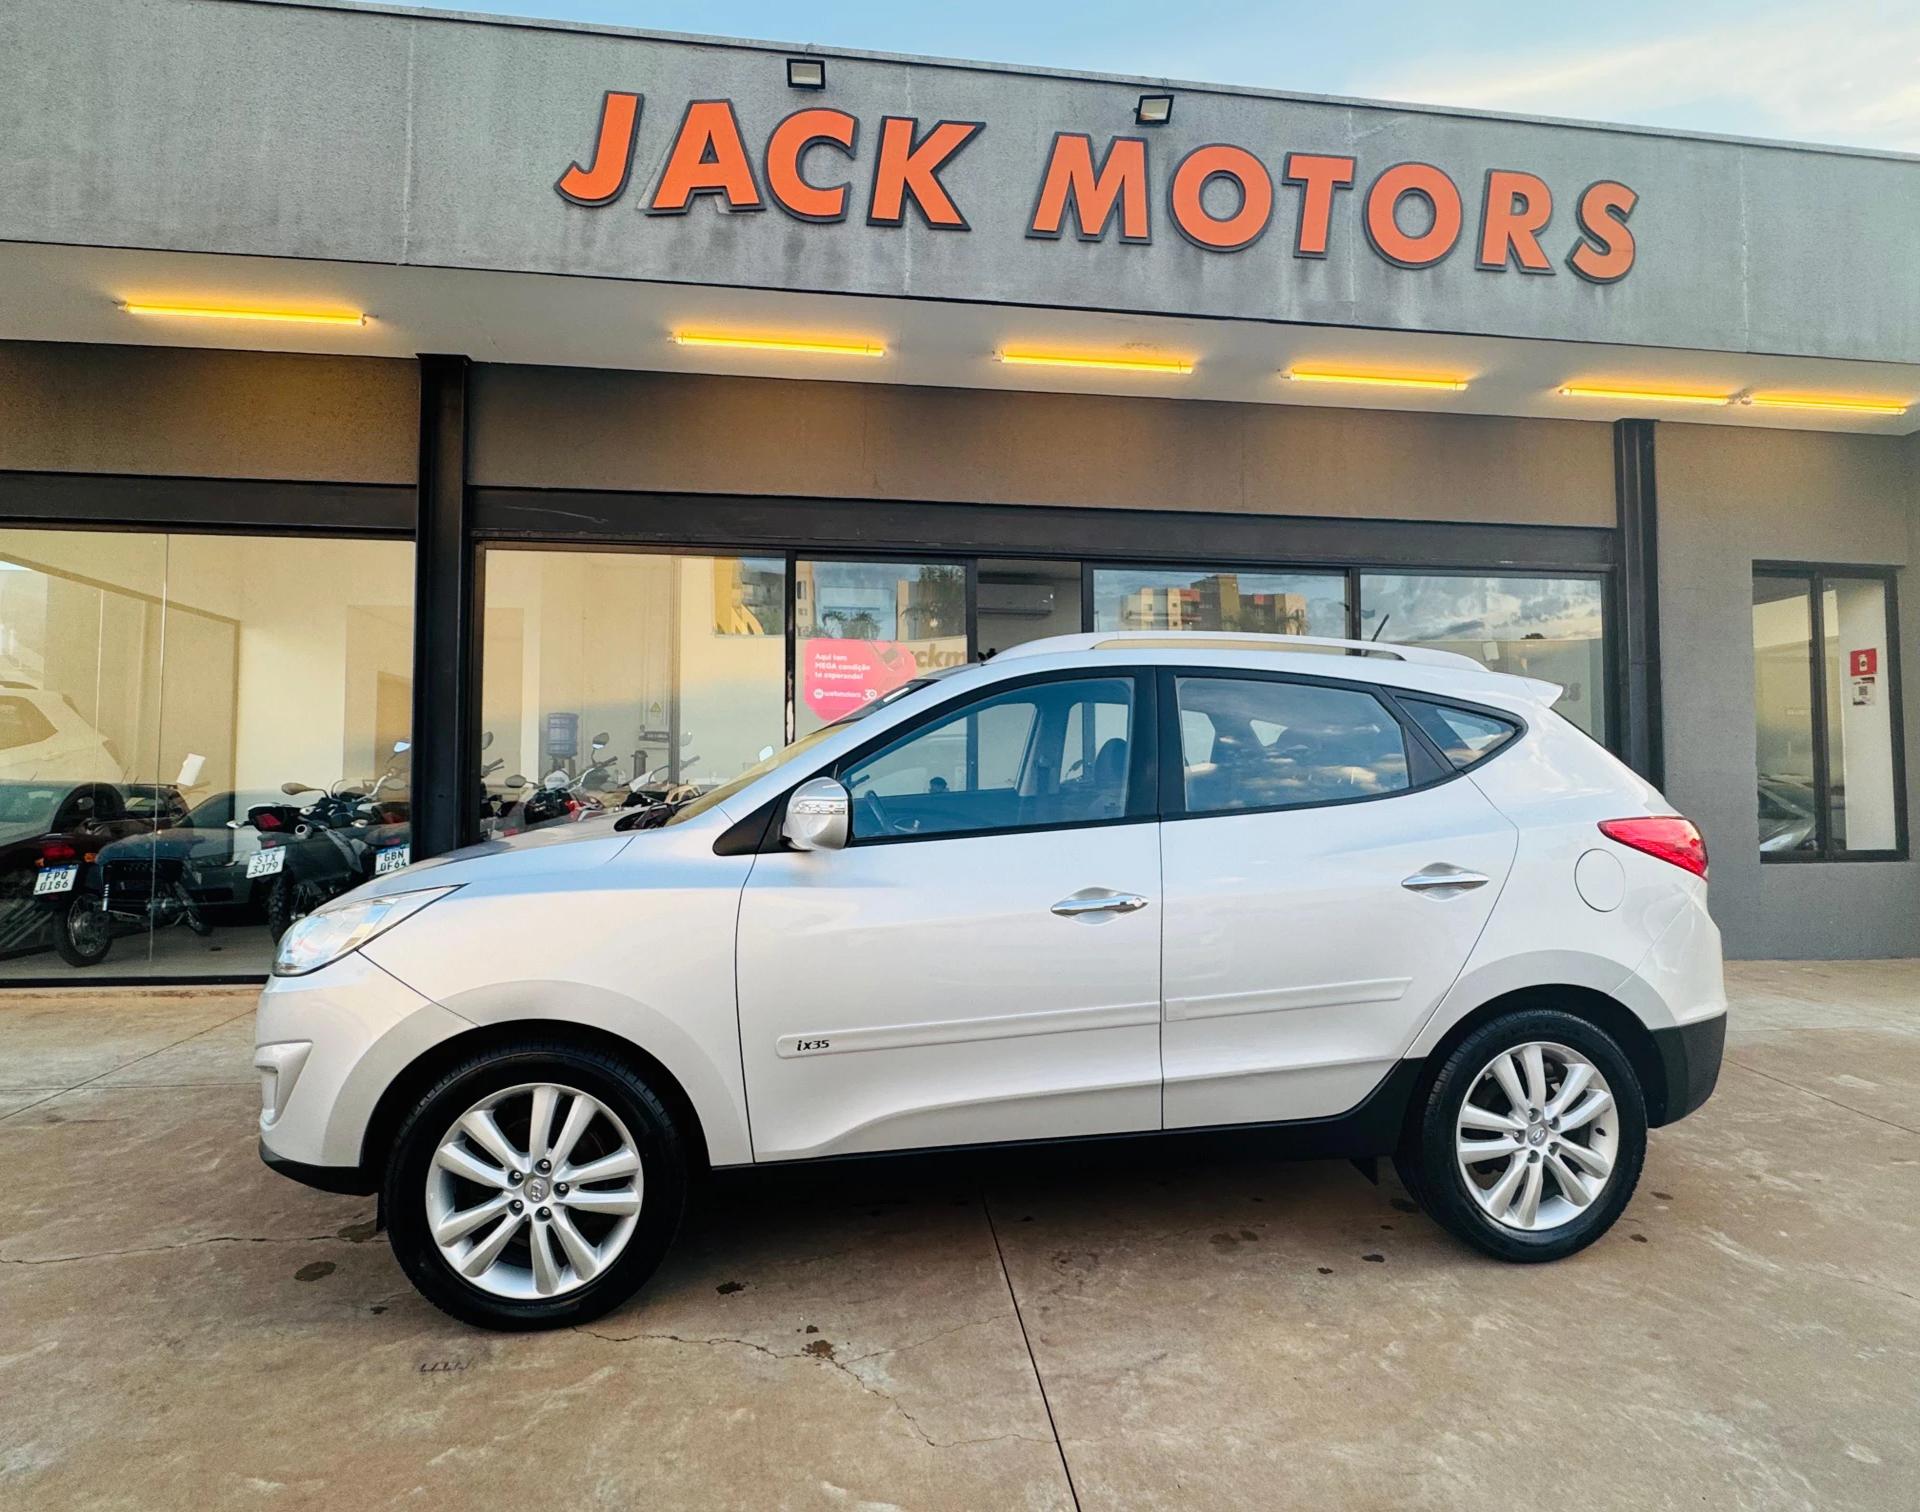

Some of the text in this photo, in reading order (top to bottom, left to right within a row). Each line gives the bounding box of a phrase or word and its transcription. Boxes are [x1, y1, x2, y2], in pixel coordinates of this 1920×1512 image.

[554, 90, 1640, 284] JACK MOTORS
[911, 643, 966, 668] ckm
[815, 662, 871, 671] MEGA condição
[256, 853, 276, 865] STX
[384, 850, 404, 862] GBN
[250, 861, 279, 875] 3J79
[46, 871, 69, 881] FPQ
[797, 1040, 830, 1051] ix35
